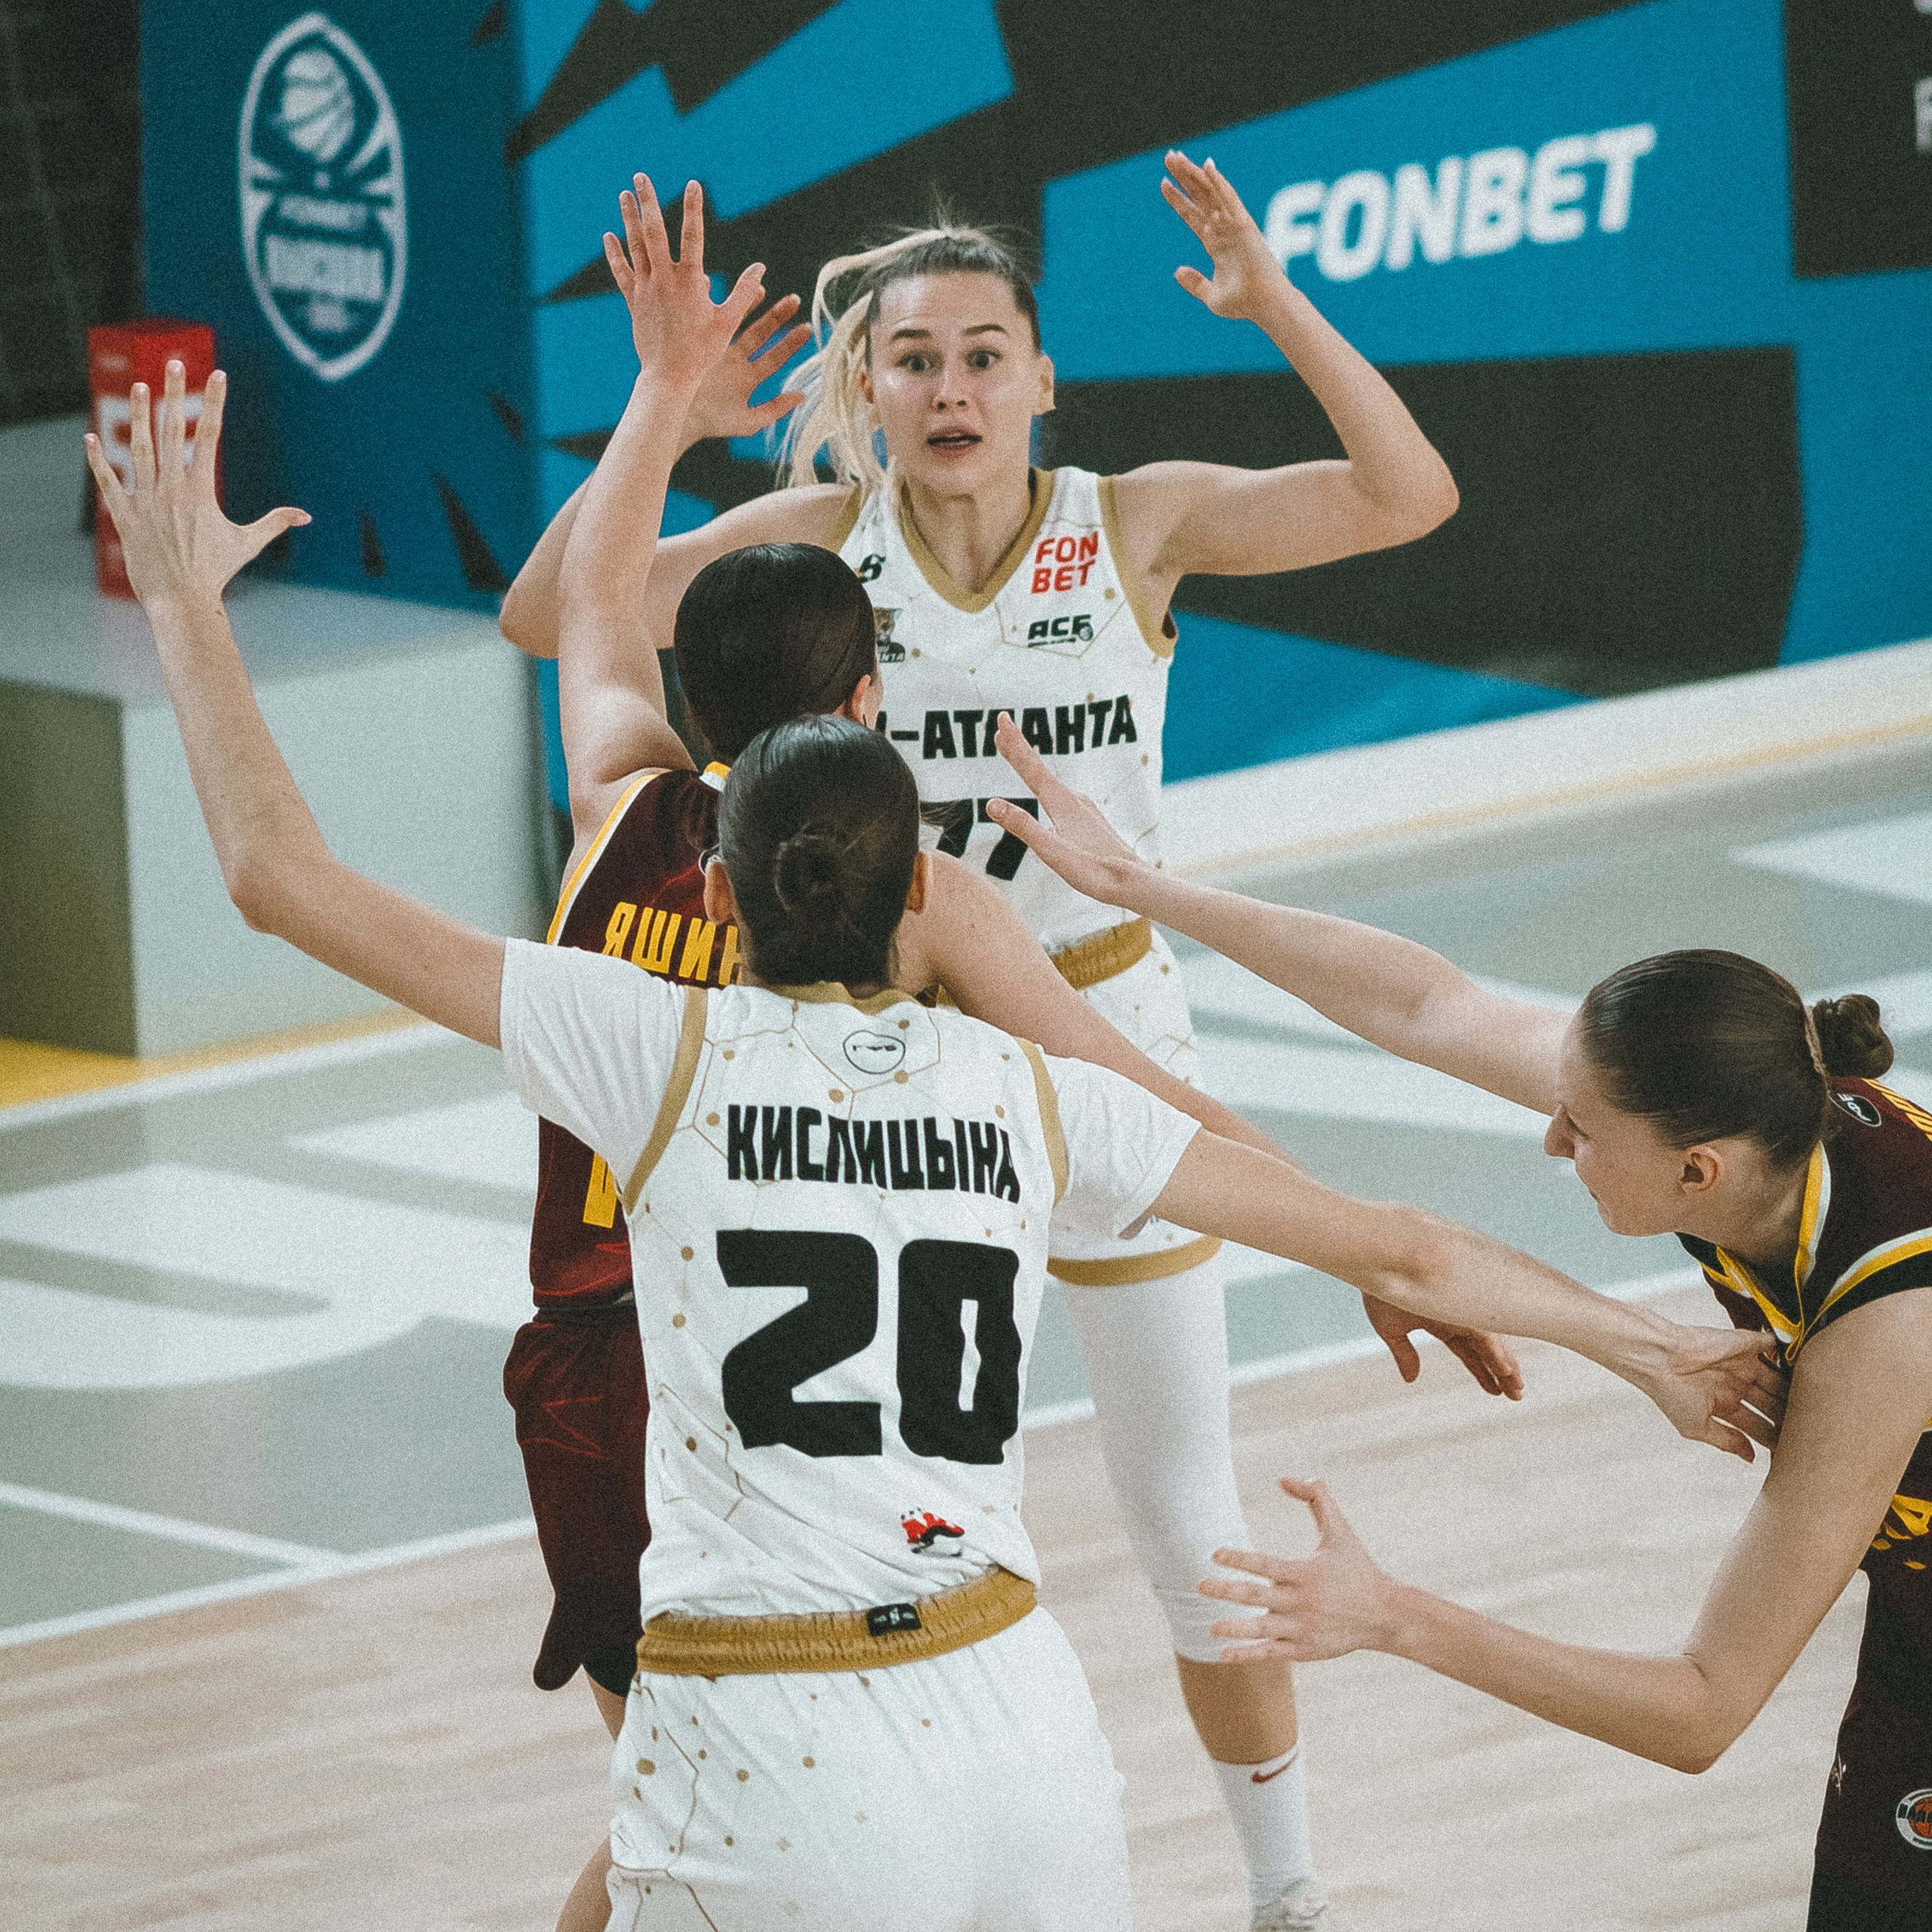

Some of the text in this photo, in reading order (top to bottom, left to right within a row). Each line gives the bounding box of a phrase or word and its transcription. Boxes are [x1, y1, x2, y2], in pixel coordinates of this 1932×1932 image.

[1265, 122, 1657, 283] FONBET
[1031, 559, 1097, 595] BET
[1035, 531, 1099, 565] FON
[728, 1104, 1020, 1204] КИСЛИЦЫНА
[716, 1230, 1023, 1465] 20
